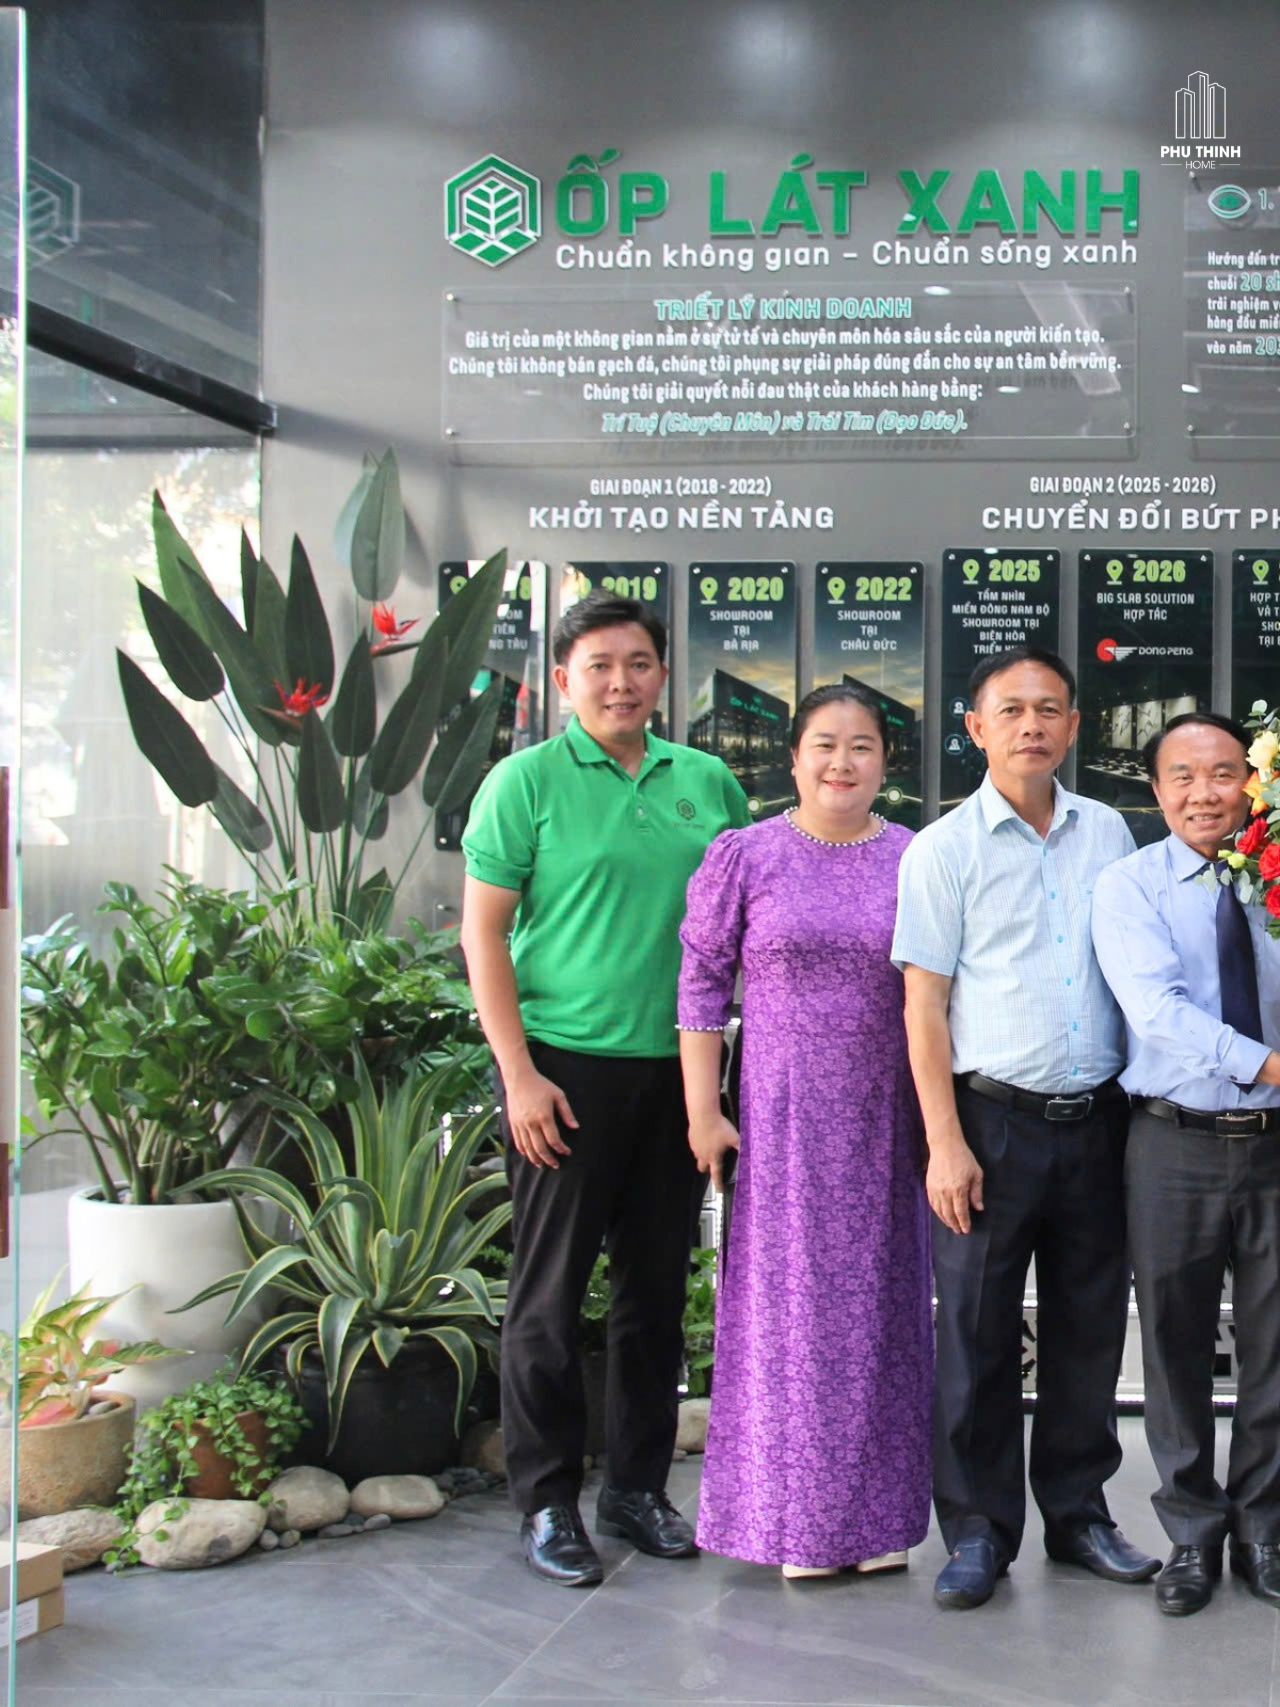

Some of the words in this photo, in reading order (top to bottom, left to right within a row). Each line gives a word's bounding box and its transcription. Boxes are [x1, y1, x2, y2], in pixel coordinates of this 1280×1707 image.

[556, 149, 667, 235] ỐP
[708, 153, 865, 234] LÁT
[898, 169, 1138, 232] XANH
[556, 240, 650, 268] Chuẩn
[664, 244, 754, 271] không
[765, 247, 829, 271] gian
[873, 238, 968, 264] Chuẩn
[981, 239, 1051, 268] sống
[1063, 239, 1136, 262] xanh
[655, 291, 723, 320] TRIẾT
[728, 293, 756, 320] LÝ
[760, 298, 820, 320] KINH
[826, 297, 912, 319] DOANH
[584, 383, 629, 404] Chúng
[632, 383, 652, 400] tôi
[656, 381, 683, 403] giải
[686, 379, 728, 403] quyết
[732, 379, 754, 399] nỗi
[758, 382, 784, 398] đau
[787, 381, 820, 402] thật
[823, 379, 850, 398] của
[853, 380, 898, 398] khách
[902, 380, 938, 401] hàng
[941, 379, 982, 401] bằng:
[590, 479, 619, 495] GIAI
[622, 479, 662, 498] ĐOẠN
[664, 479, 674, 494] 1
[676, 476, 718, 497] (2018
[729, 476, 771, 496] 2022)
[1030, 477, 1058, 492] GIAI
[1062, 477, 1102, 496] ĐOẠN
[1106, 477, 1114, 492] 2
[1118, 474, 1160, 495] (2025
[1173, 475, 1216, 495] 2026)
[530, 500, 602, 528] KHỞI
[610, 507, 668, 532] TẠO
[678, 499, 742, 528] NỀN
[750, 500, 834, 528] TẢNG
[982, 499, 1108, 529] CHUYỂN
[1118, 499, 1170, 529] ĐỔI
[1182, 503, 1240, 529] BỨT
[989, 559, 1040, 582] 2025
[1133, 560, 1186, 582] 2026
[728, 577, 784, 601] 2020
[856, 577, 912, 600] 2022
[1097, 593, 1114, 603] BIG
[1117, 593, 1142, 604] SLAB
[1145, 593, 1194, 604] SOLUTION
[1250, 592, 1271, 604] HỢP
[710, 610, 773, 621] SHOWROOM
[838, 610, 901, 620] SHOWROOM
[1124, 609, 1145, 622] HỢP
[1148, 607, 1167, 620] TÁC
[1258, 603, 1270, 616] VÀ
[962, 618, 1020, 628] SHOWROOM
[1024, 619, 1039, 629] TẠI
[841, 638, 870, 650] CHÂU
[873, 638, 897, 650] ĐỨC
[980, 630, 1002, 641] BIÊN
[1005, 630, 1025, 641] HÒA
